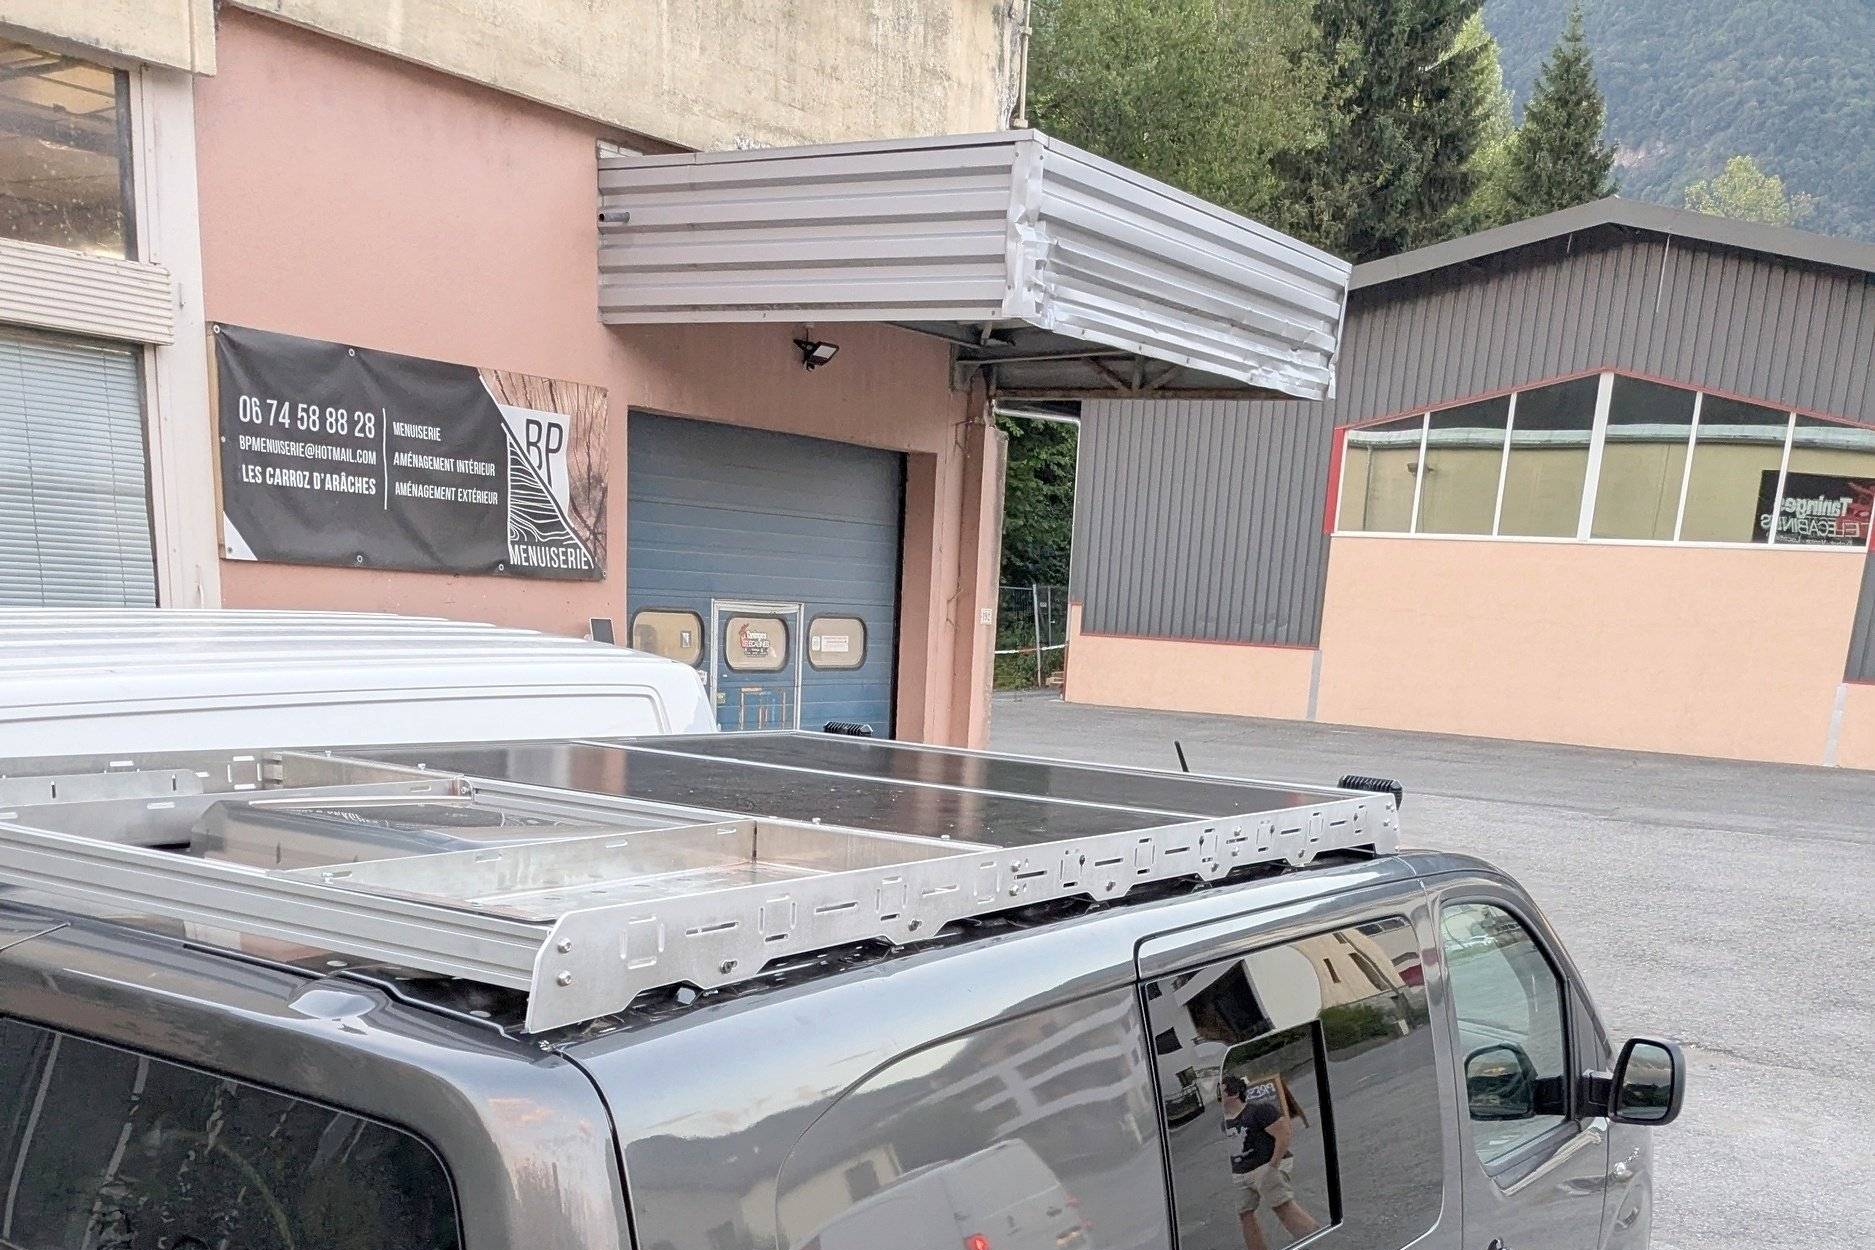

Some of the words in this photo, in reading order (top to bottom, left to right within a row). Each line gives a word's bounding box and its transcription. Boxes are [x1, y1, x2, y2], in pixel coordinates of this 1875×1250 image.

[239, 395, 262, 424] 06
[266, 399, 290, 428] 74
[297, 403, 320, 432] 58
[325, 407, 348, 435] 88
[354, 411, 375, 438] 28
[392, 421, 441, 441] MENUISERIE
[239, 434, 377, 465] BPMENUISERIE@HOTMAIL.COM
[524, 418, 564, 492] BP
[393, 451, 454, 472] AMÉNAGEMENT
[456, 459, 496, 477] INTÉRIEUR
[242, 464, 262, 484] LES
[265, 467, 310, 489] CARROZ
[313, 472, 376, 495] D'ARÂCHES
[395, 481, 456, 501] AMÉNAGEMENT
[457, 487, 498, 505] EXTÉRIEUR
[509, 545, 589, 570] MENUISERIE
